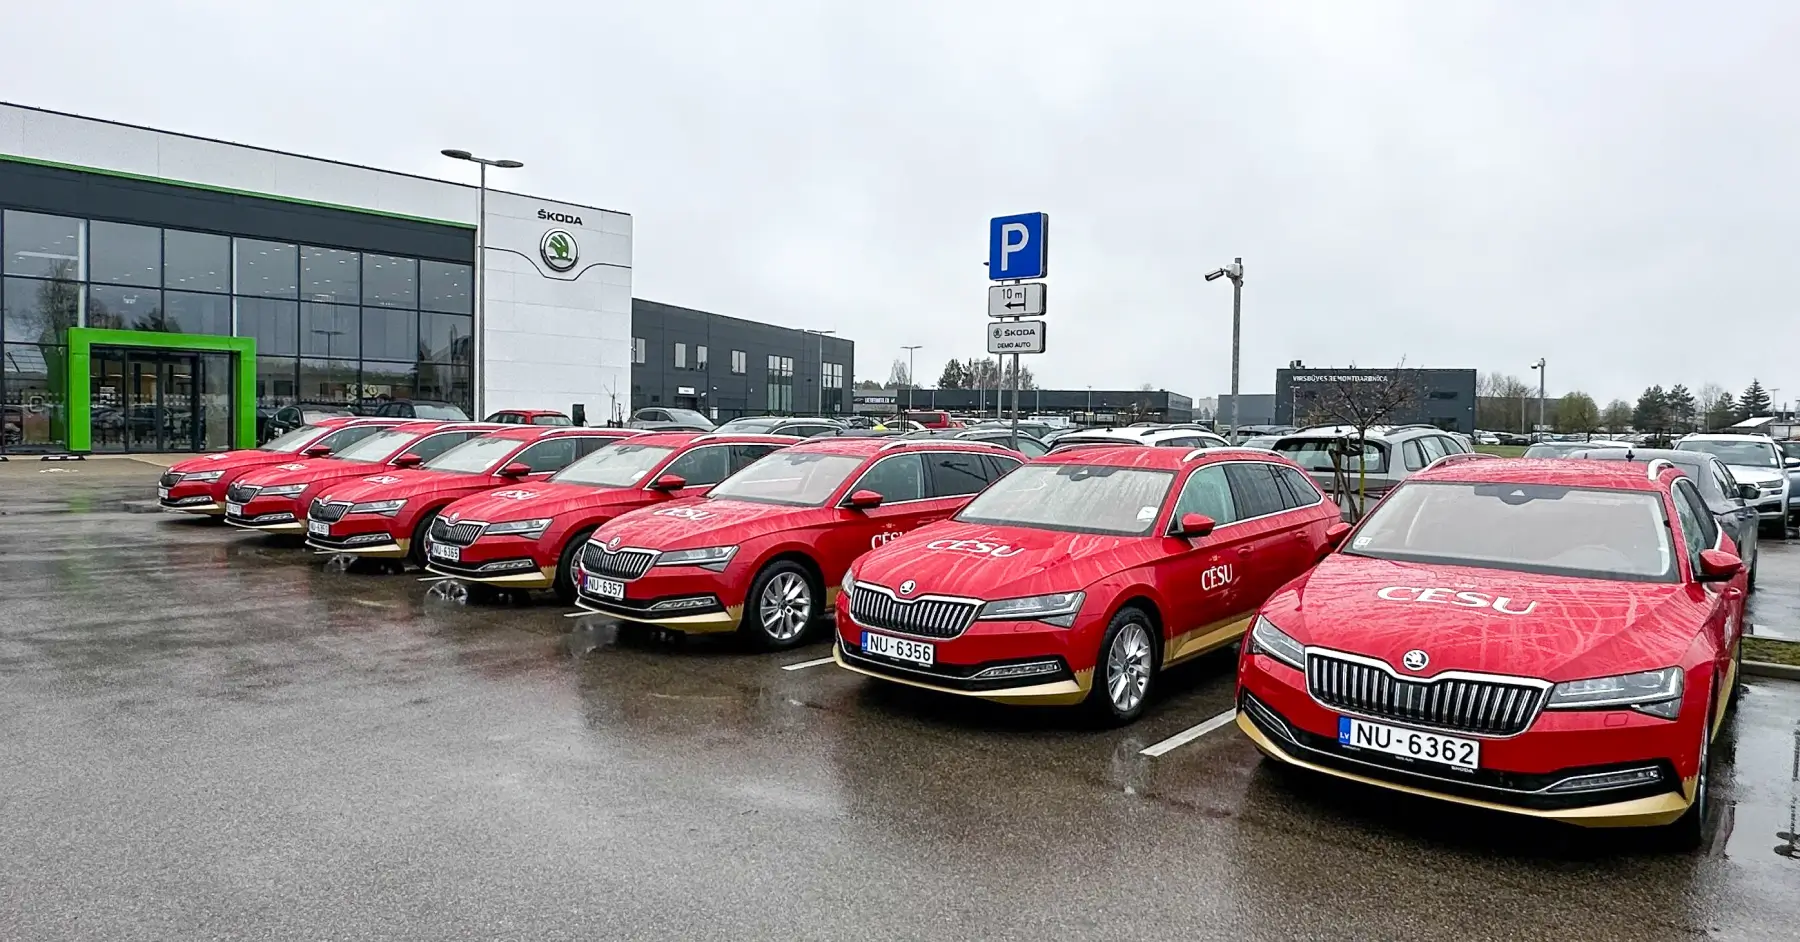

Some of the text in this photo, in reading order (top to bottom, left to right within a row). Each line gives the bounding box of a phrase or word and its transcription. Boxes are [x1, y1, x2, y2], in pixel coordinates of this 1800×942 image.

[538, 209, 582, 225] ŠKODA
[1001, 223, 1029, 271] P
[1002, 289, 1023, 299] 10 m
[1004, 328, 1036, 337] ŠKODA
[1201, 563, 1233, 591] CĒSU
[870, 634, 931, 661] NU-6356
[1356, 723, 1474, 765] NU-6362
